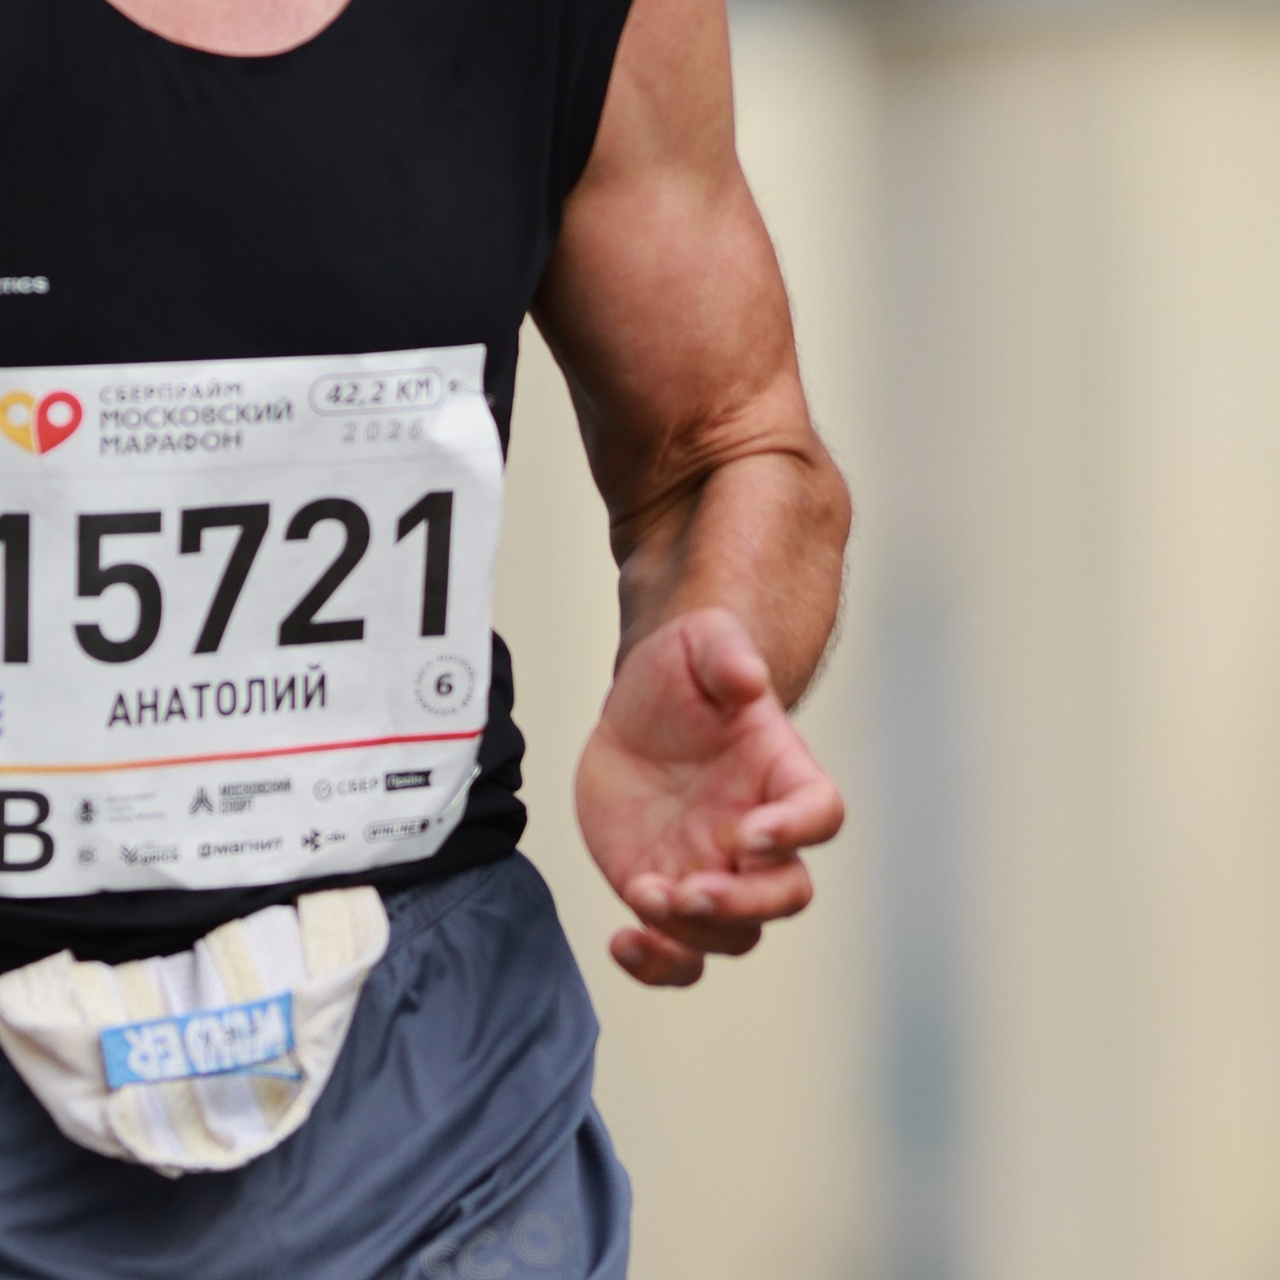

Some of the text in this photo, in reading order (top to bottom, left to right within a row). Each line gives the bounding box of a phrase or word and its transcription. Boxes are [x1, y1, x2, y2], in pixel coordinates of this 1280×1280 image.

[99, 380, 241, 405] СБЕРПРАЙМ
[100, 397, 294, 430] МОСКОВСКИЙ
[100, 430, 242, 455] МАРАФОН
[107, 663, 328, 728] АНАТОЛИЙ
[436, 673, 453, 697] 6
